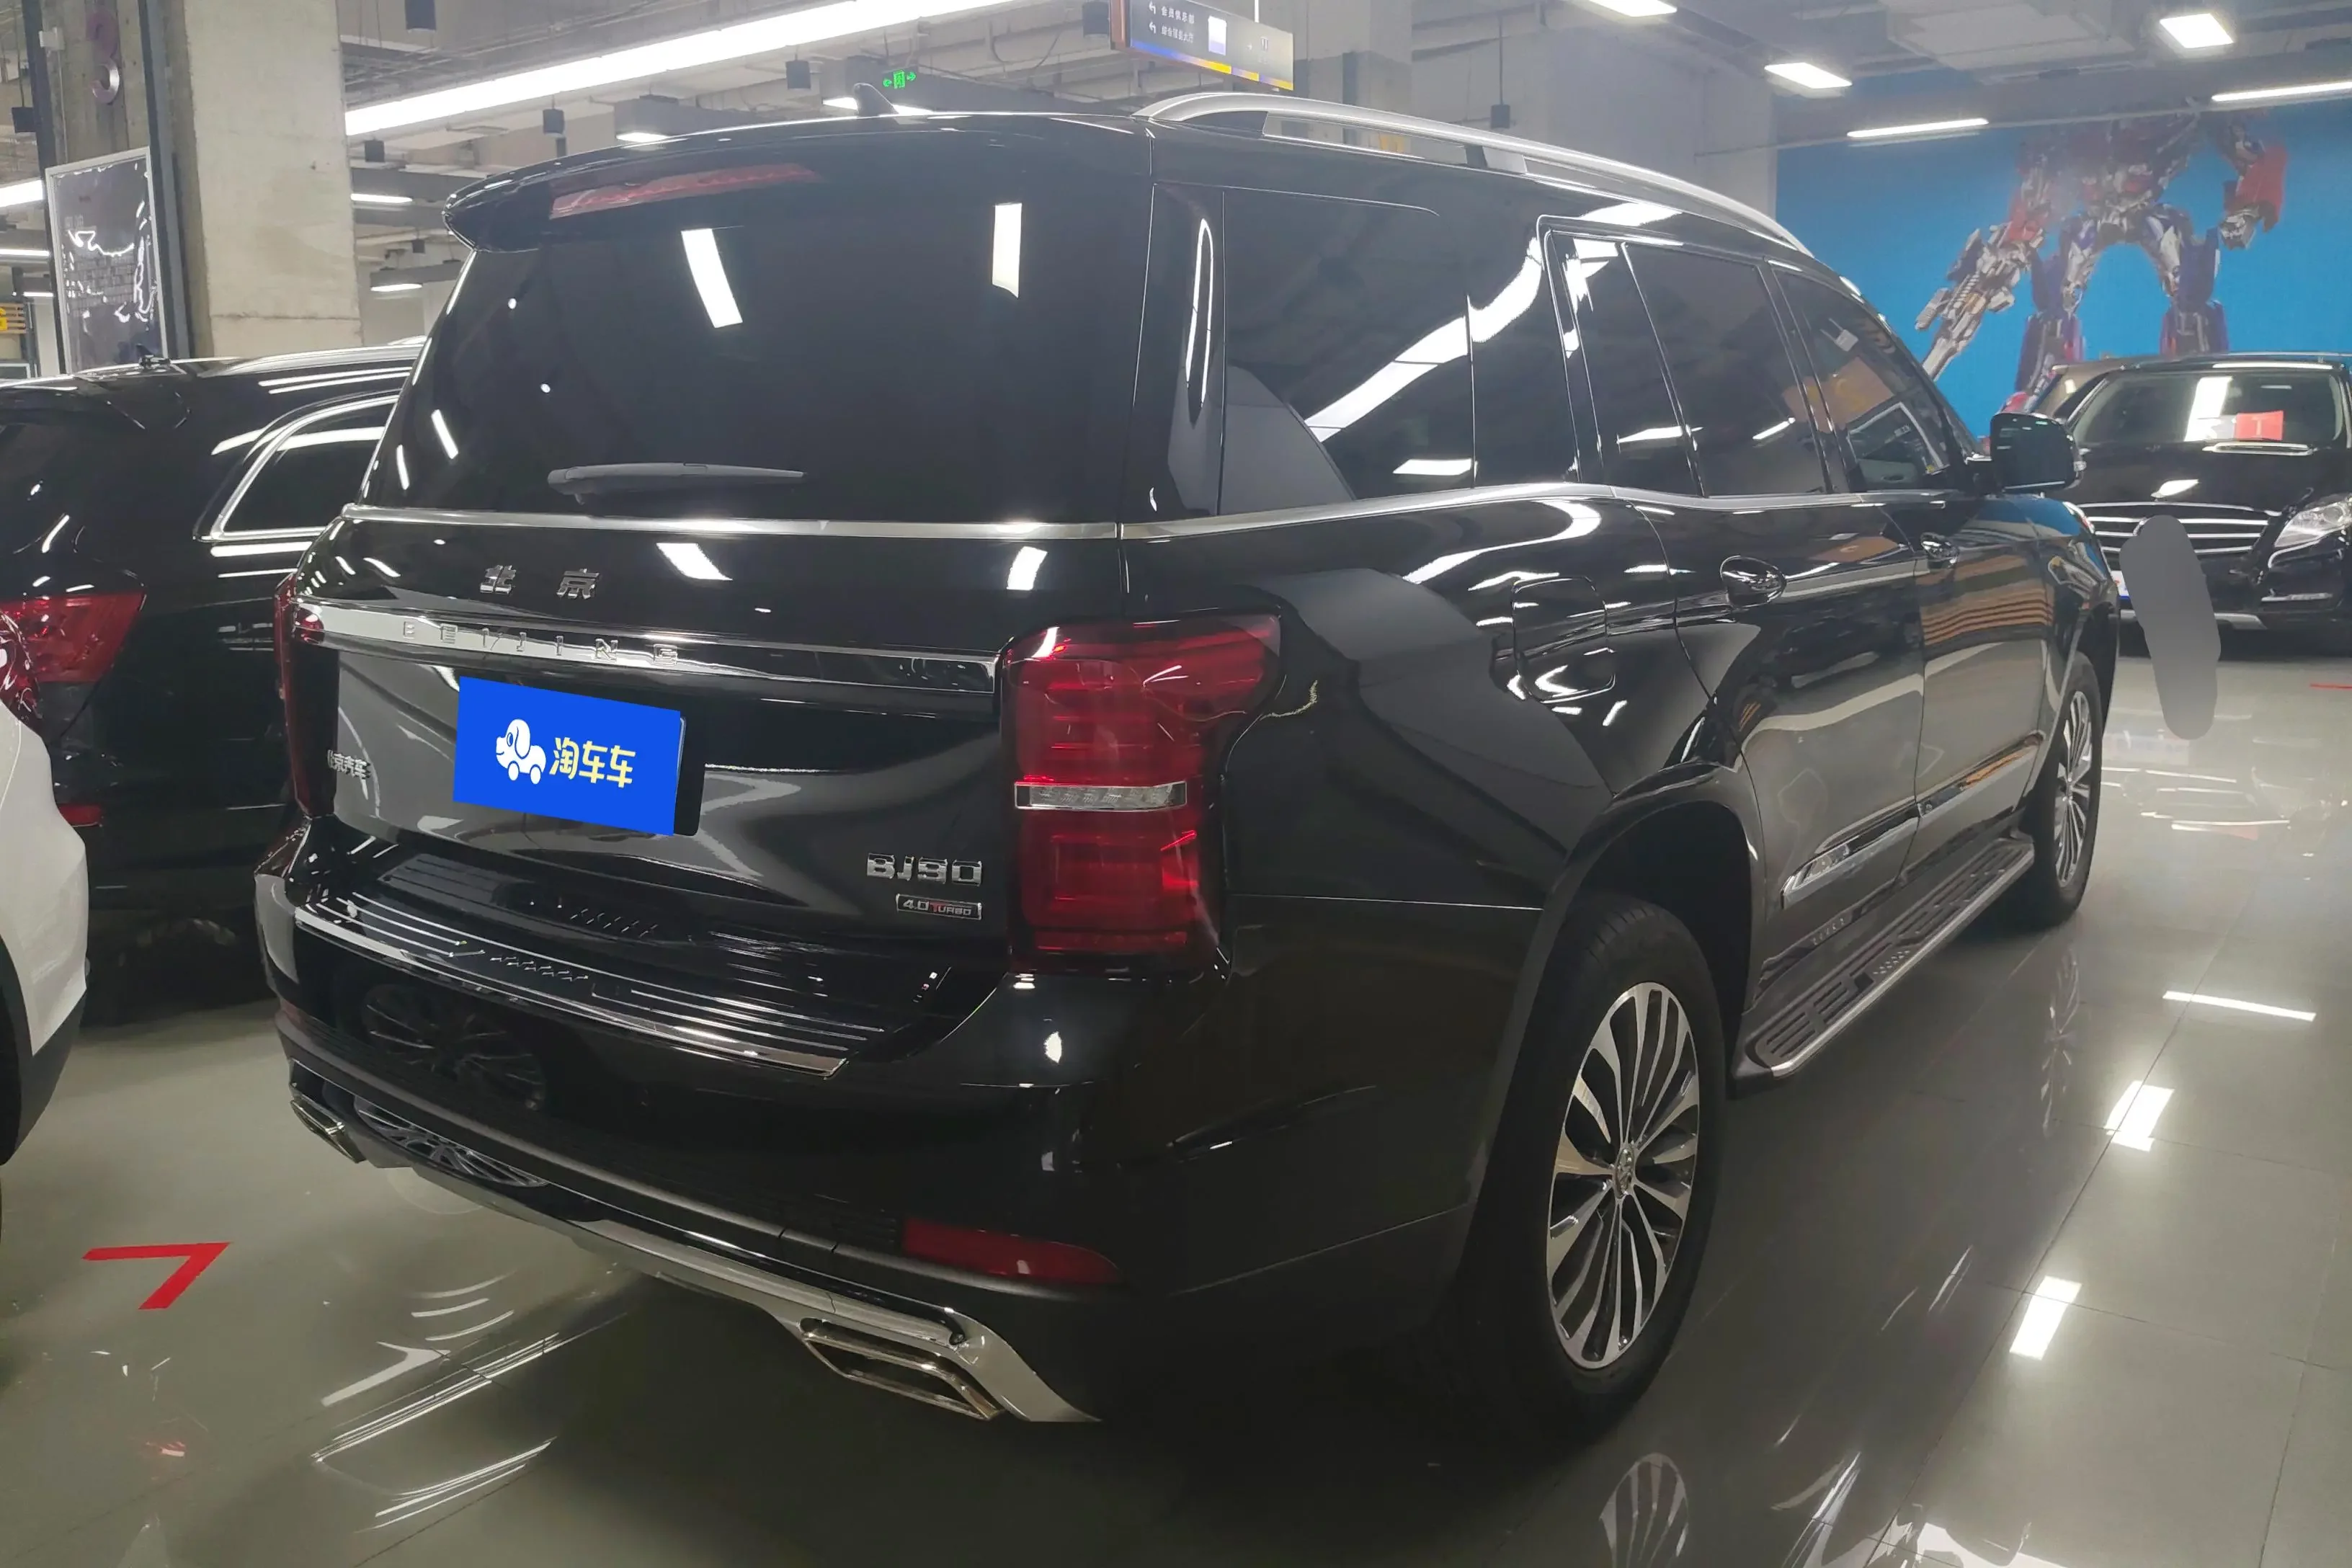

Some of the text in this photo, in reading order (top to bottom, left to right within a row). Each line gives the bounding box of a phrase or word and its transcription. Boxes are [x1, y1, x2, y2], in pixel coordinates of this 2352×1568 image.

[480, 565, 600, 600] 北京
[403, 620, 679, 667] BEIJING
[867, 852, 982, 886] BJ90
